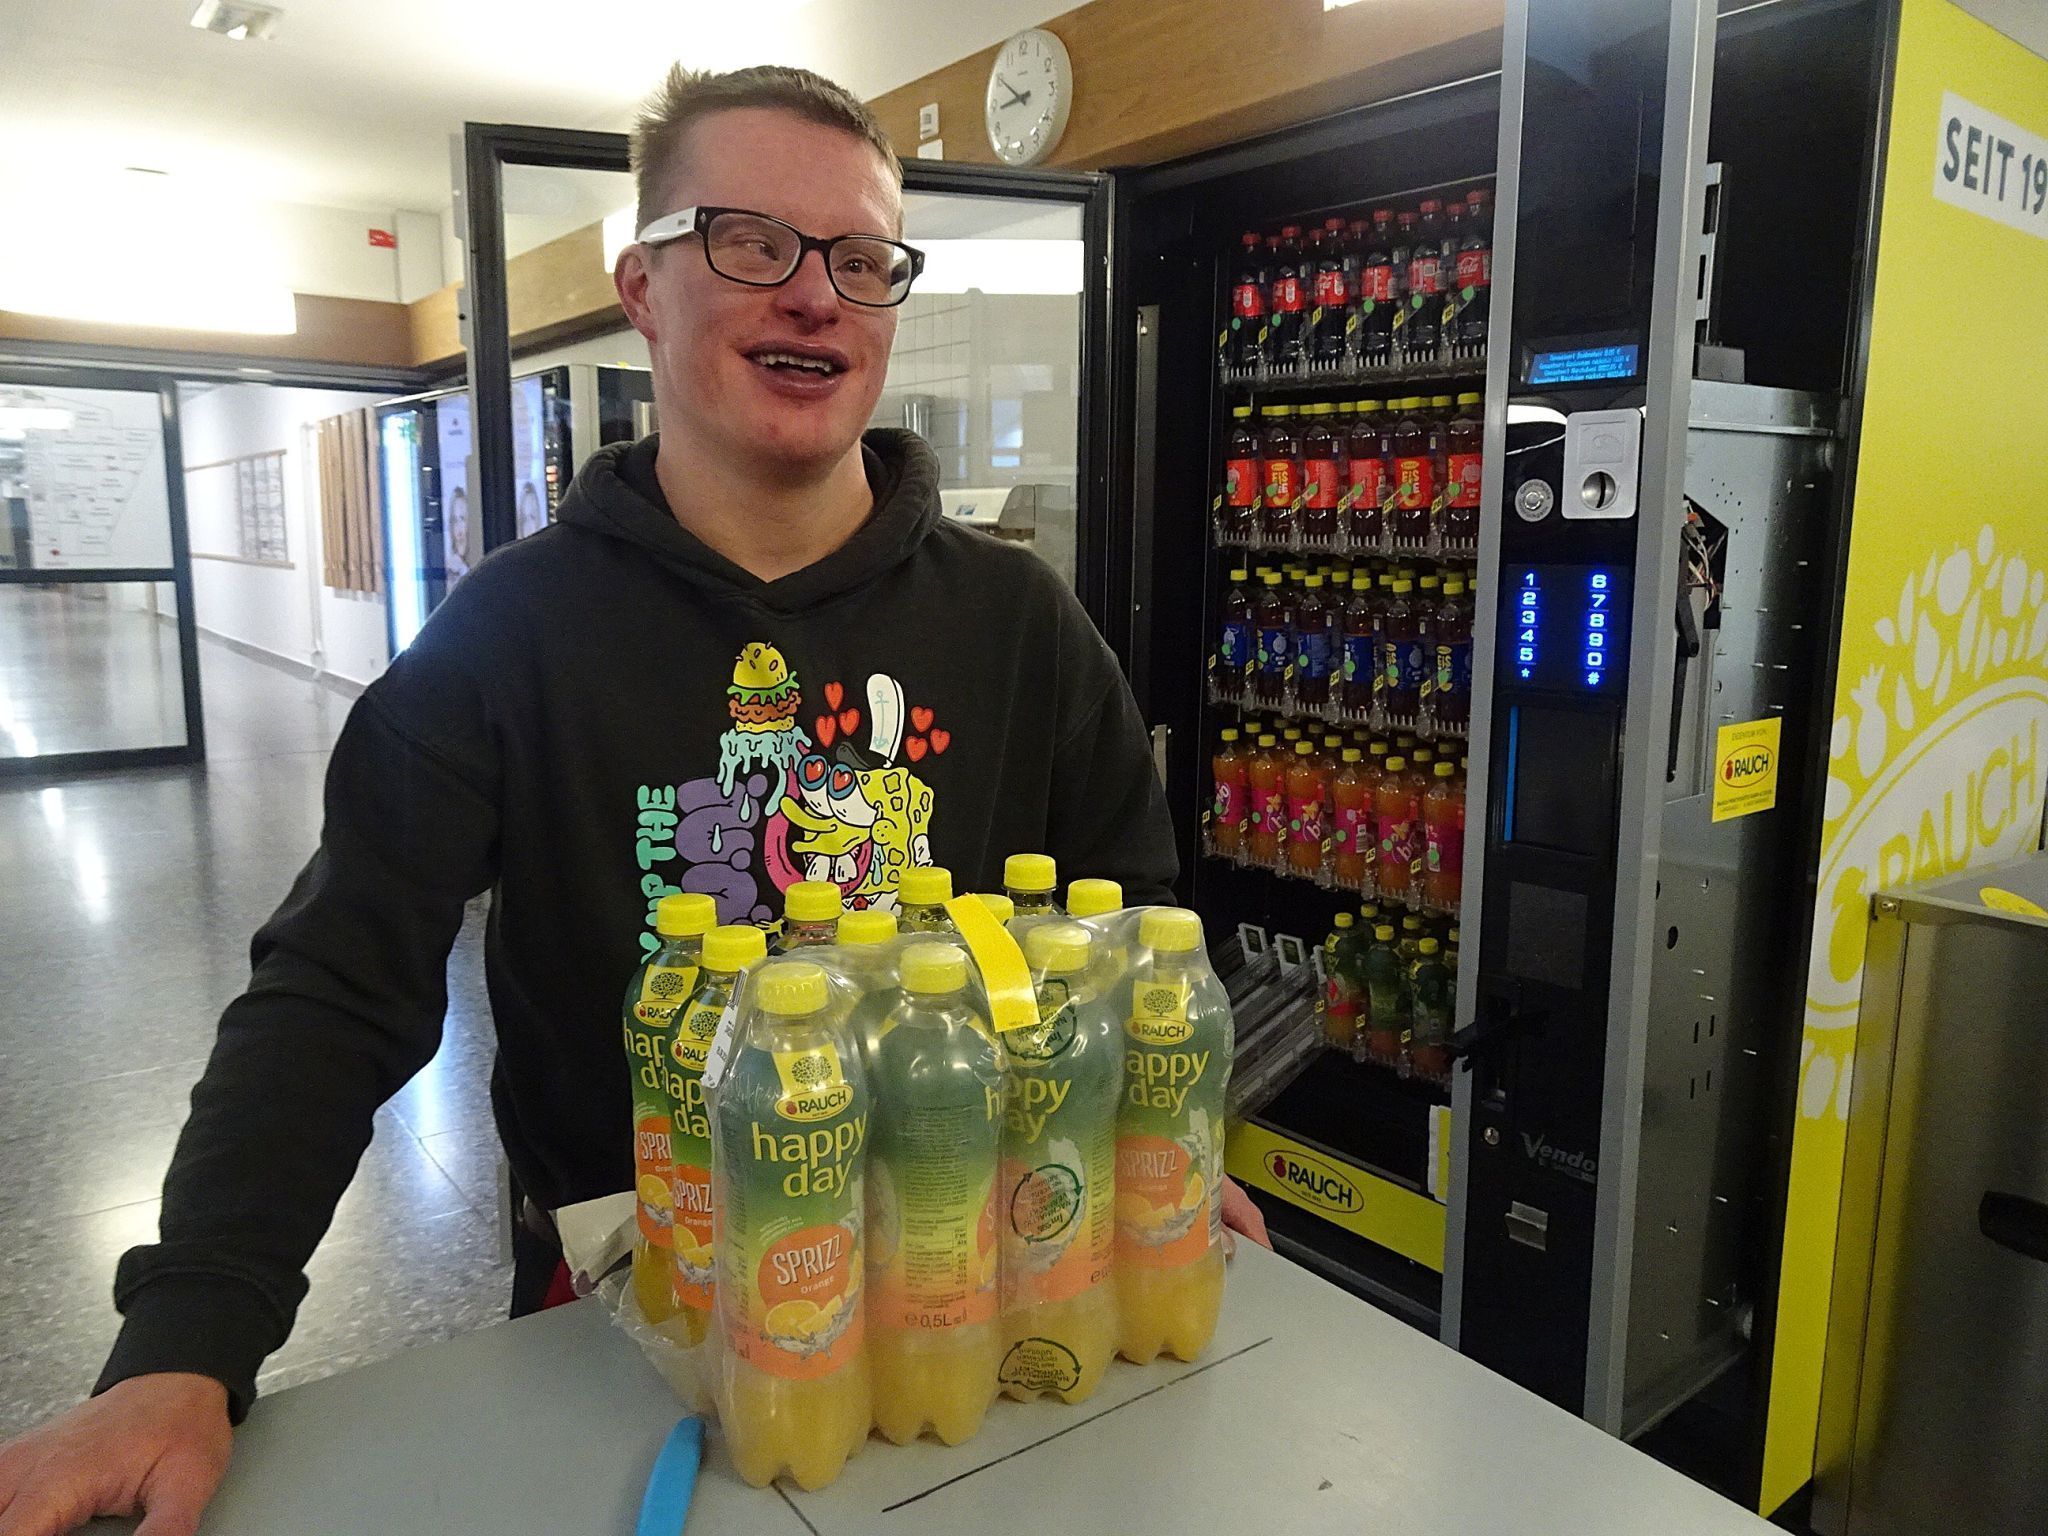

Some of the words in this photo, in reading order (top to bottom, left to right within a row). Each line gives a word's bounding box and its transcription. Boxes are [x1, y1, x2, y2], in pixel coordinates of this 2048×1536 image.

[1019, 40, 1028, 56] 12
[1044, 57, 1052, 73] 2
[1048, 80, 1055, 97] 3
[1943, 117, 2015, 201] SEIT
[2022, 154, 2048, 215] 19
[1526, 573, 1534, 586] 1
[1592, 574, 1607, 588] 6
[1523, 592, 1536, 605] 2
[1592, 594, 1606, 608] 7
[1522, 610, 1535, 624] 3
[1590, 613, 1604, 627] 8
[1521, 629, 1534, 642] 4
[1589, 633, 1603, 647] 9
[1520, 648, 1533, 661] 5
[1588, 652, 1602, 666] 0
[1734, 753, 1769, 778] RAUCH
[636, 784, 678, 870] THE
[1142, 1024, 1185, 1038] RAUCH
[798, 1090, 846, 1114] RAUCH
[1128, 1077, 1189, 1118] day
[674, 1104, 711, 1140] da
[752, 1110, 867, 1169] happy
[1520, 1132, 1597, 1172] Vendo
[1121, 1150, 1179, 1178] SPRIZZ
[783, 1158, 853, 1198] day
[1288, 1161, 1352, 1208] RAUCH
[772, 1234, 843, 1286] SPRIZZ
